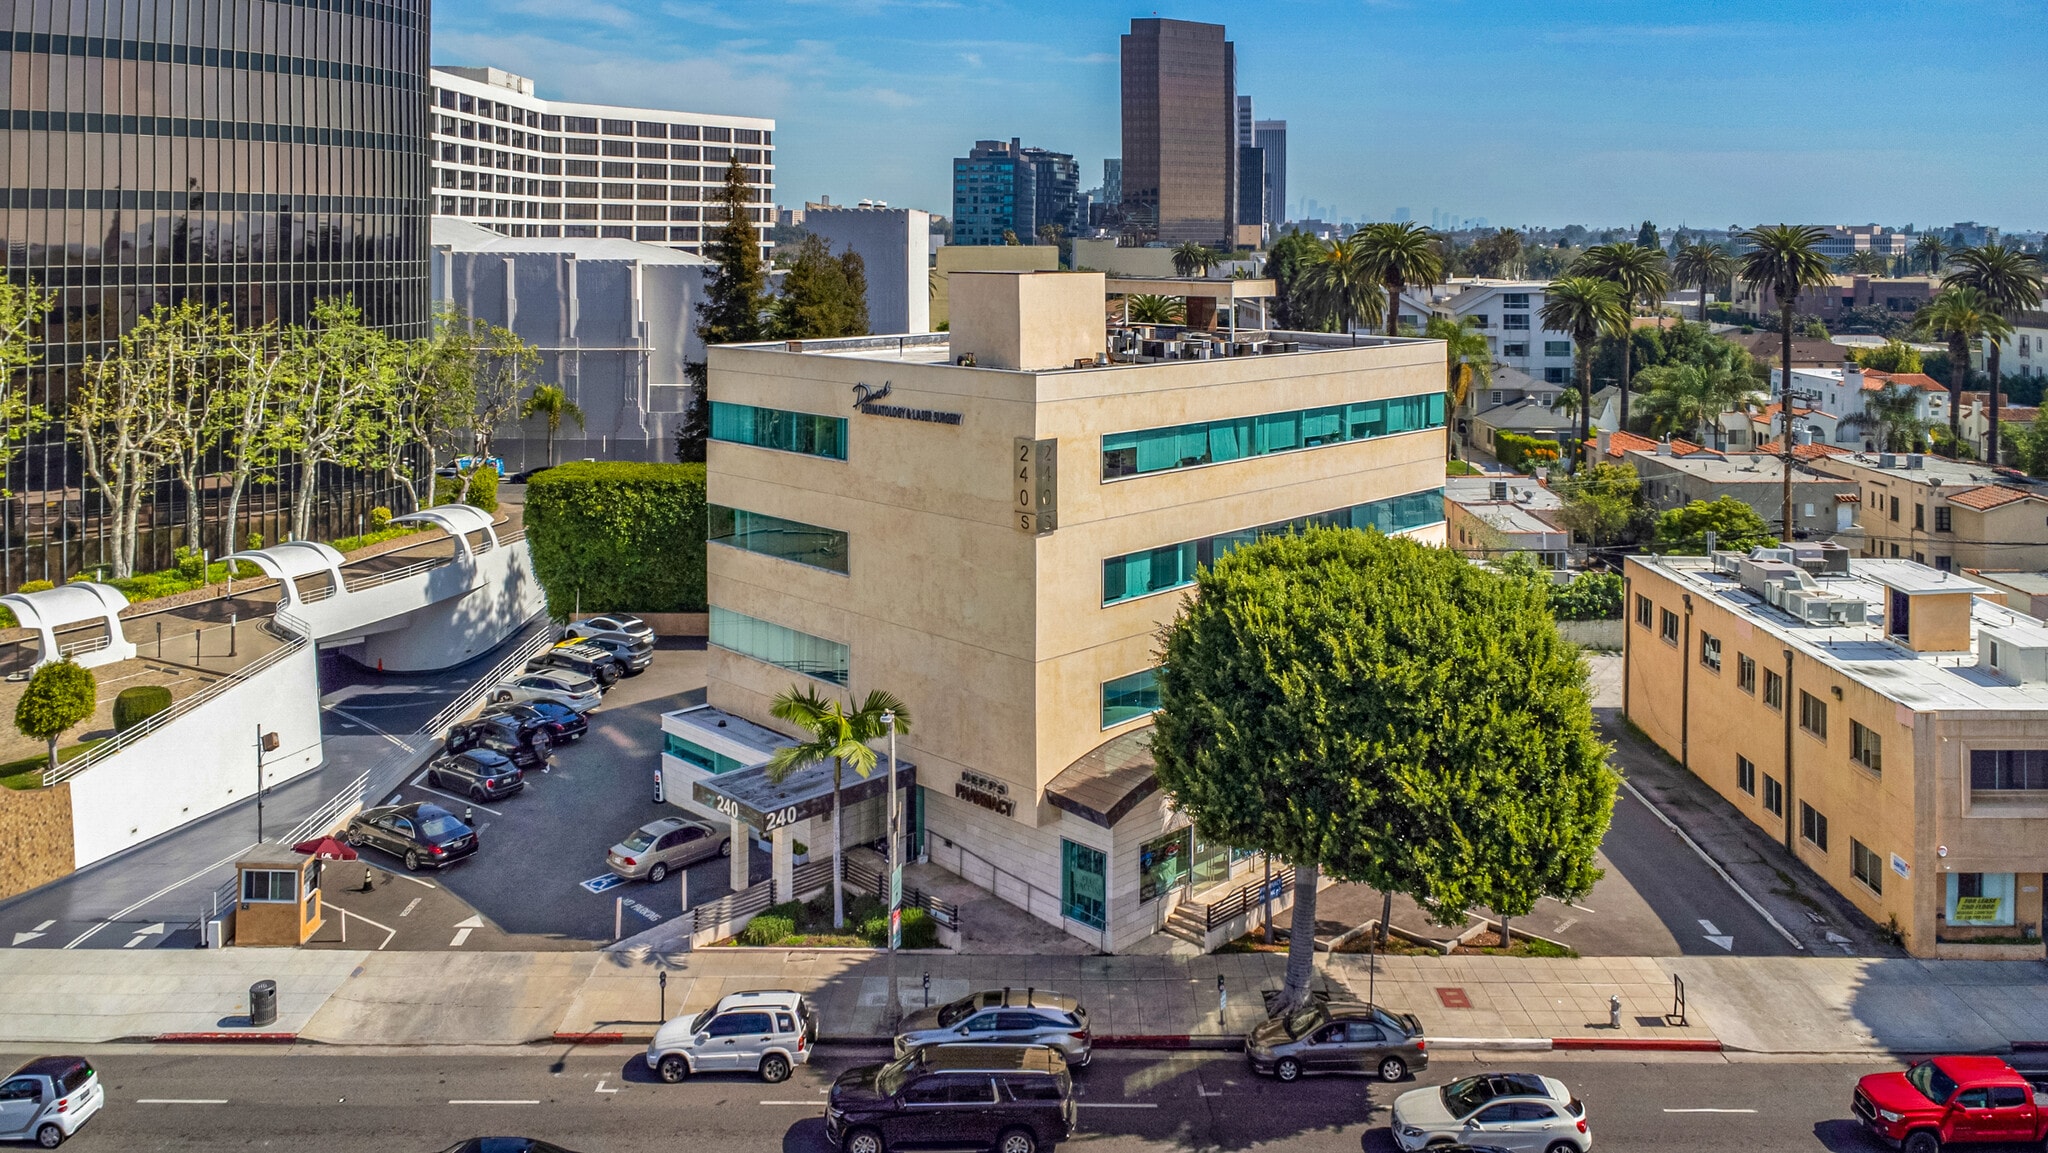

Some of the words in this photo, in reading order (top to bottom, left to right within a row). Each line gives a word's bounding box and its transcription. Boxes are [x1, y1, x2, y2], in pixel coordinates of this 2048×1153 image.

[861, 403, 906, 420] DERMATOLOGY
[912, 409, 933, 423] LASER
[934, 412, 963, 426] SURGERY
[716, 795, 739, 819] 240
[765, 806, 797, 831] 240
